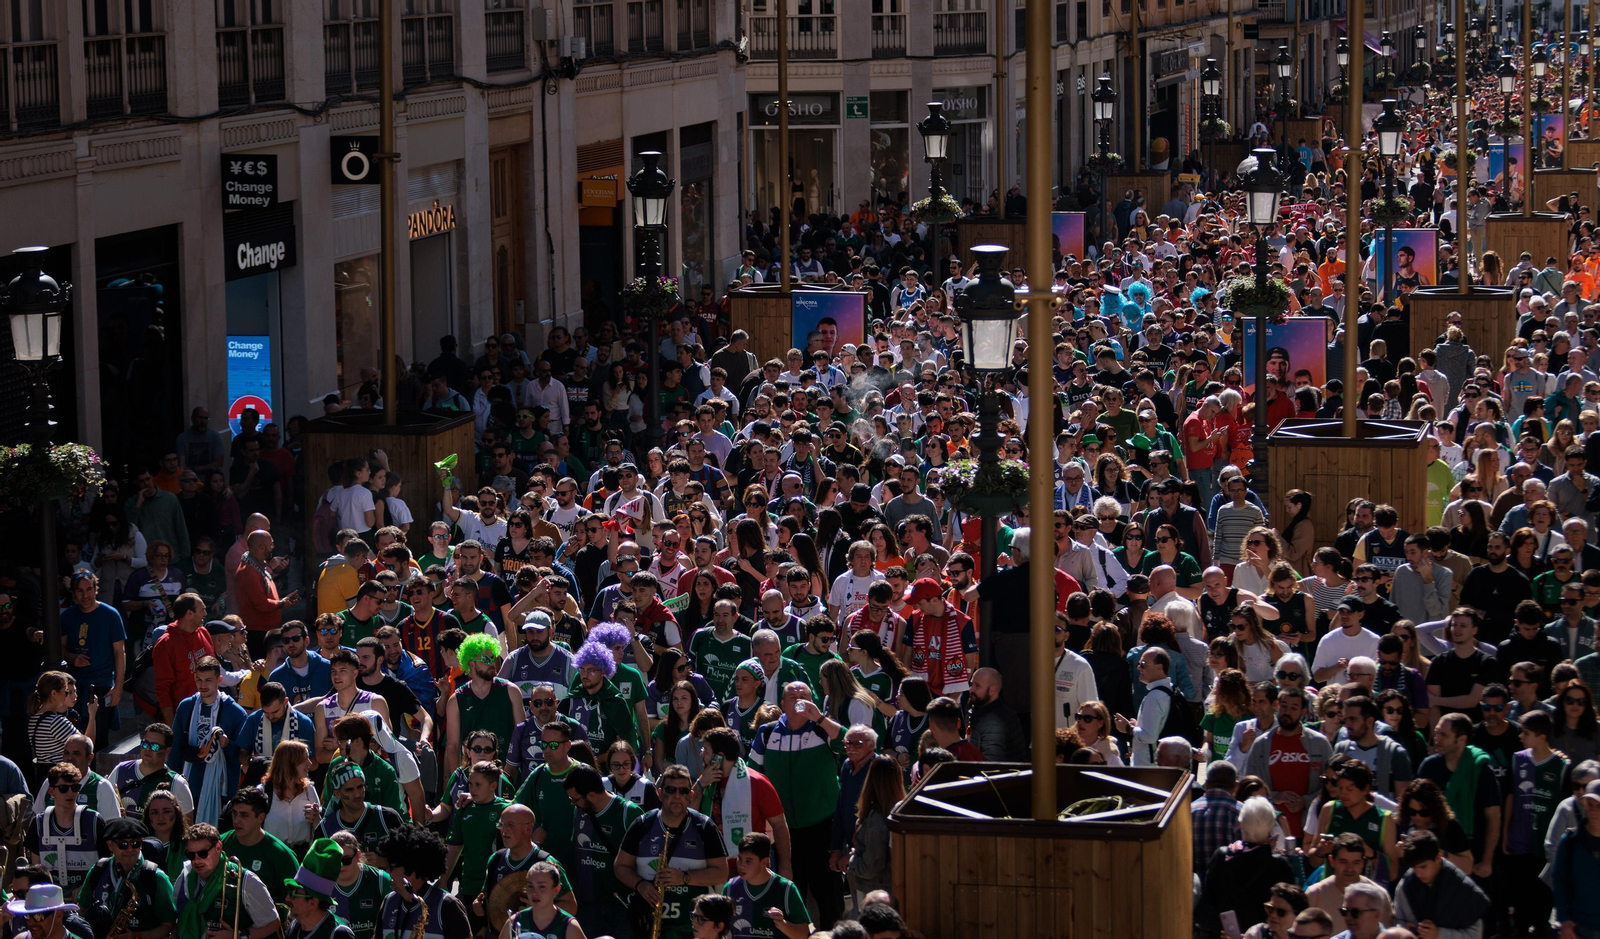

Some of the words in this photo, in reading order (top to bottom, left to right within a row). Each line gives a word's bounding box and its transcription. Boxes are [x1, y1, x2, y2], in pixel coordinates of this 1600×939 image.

[942, 97, 978, 111] OYSHO
[765, 103, 823, 117] OSHO
[225, 181, 274, 194] Change
[228, 194, 271, 207] Money
[237, 241, 286, 270] Change
[228, 341, 263, 351] Change
[228, 350, 259, 360] Money
[1072, 393, 1093, 402] DKV
[417, 635, 432, 651] 12
[946, 663, 963, 671] BAXI
[1281, 752, 1310, 763] asics
[589, 841, 608, 852] Unicaj
[661, 902, 681, 920] 25
[349, 920, 375, 931] Unicaja
[749, 927, 774, 938] Unicaja
